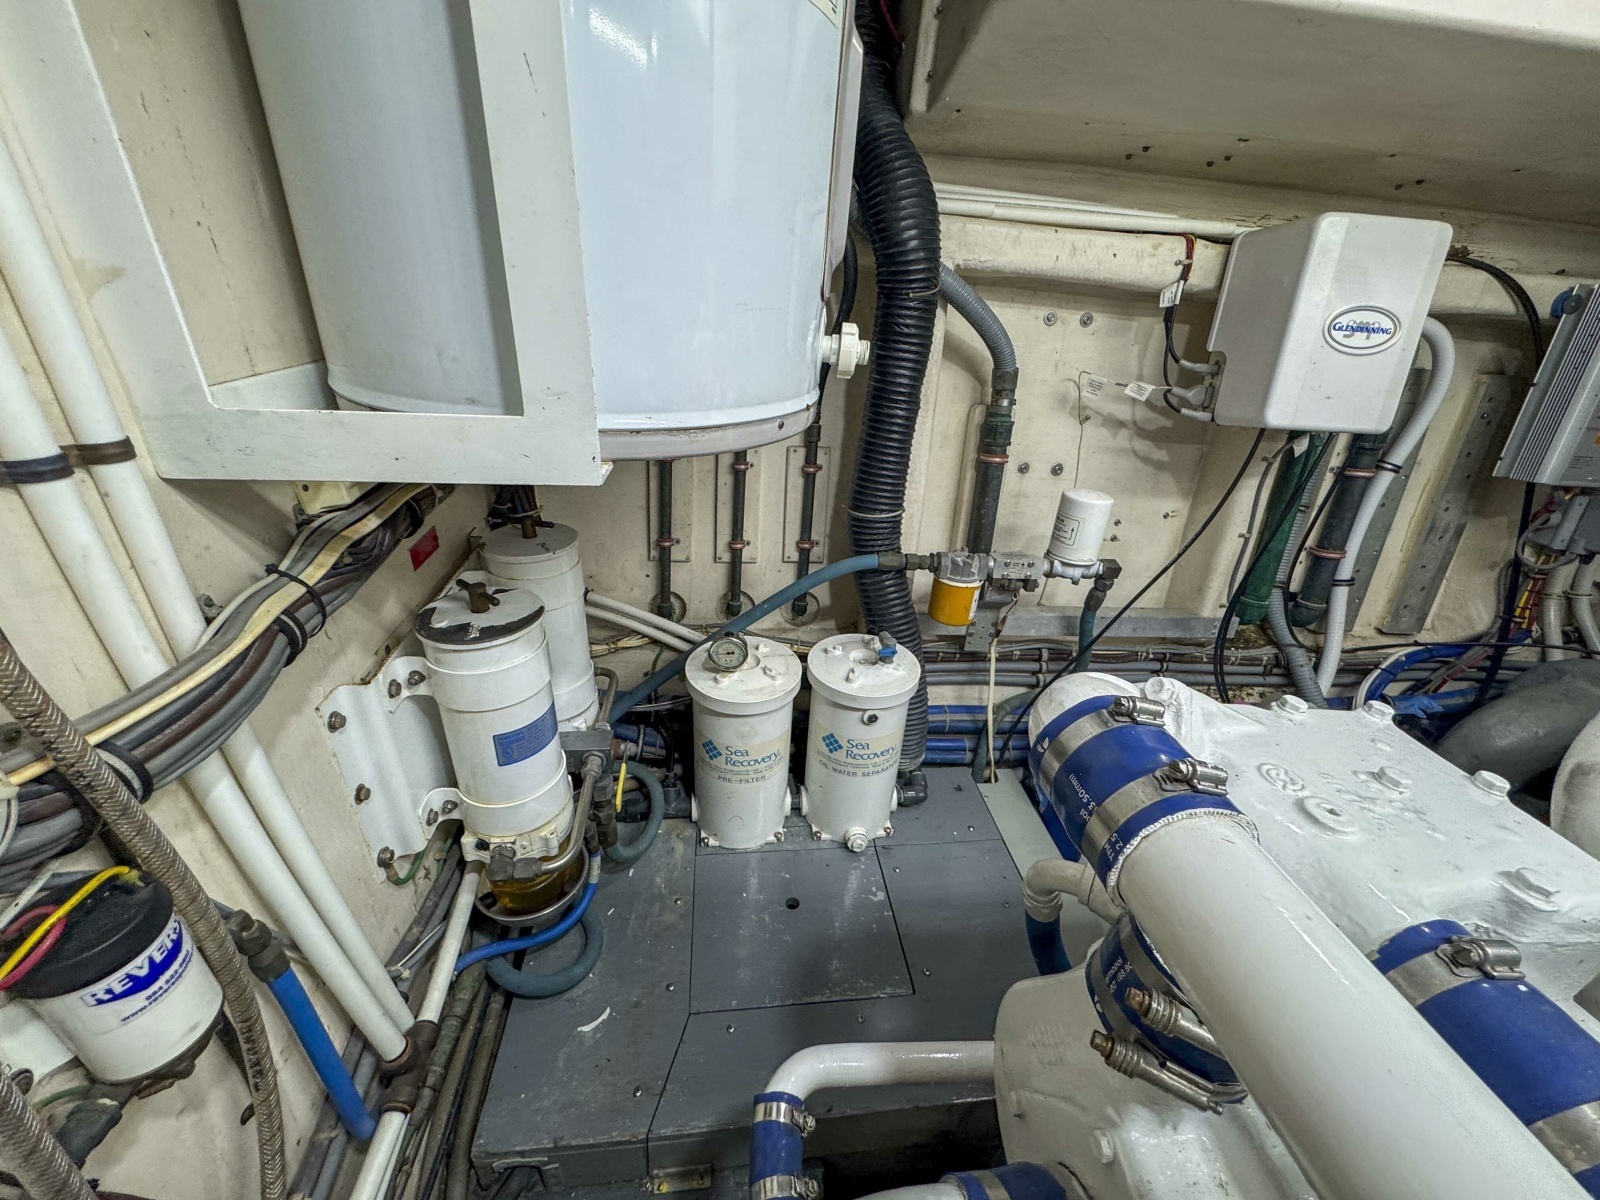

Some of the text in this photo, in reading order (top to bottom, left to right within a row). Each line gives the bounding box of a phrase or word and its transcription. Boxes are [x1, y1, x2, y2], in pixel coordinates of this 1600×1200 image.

[1332, 321, 1392, 335] GLENDINNING
[725, 745, 750, 757] Sea
[846, 738, 870, 750] Sea
[725, 749, 780, 767] Recovery
[845, 743, 896, 760] Recovery
[819, 759, 830, 770] OIL
[831, 766, 858, 777] WATER
[717, 774, 766, 784] PRE-FILTER
